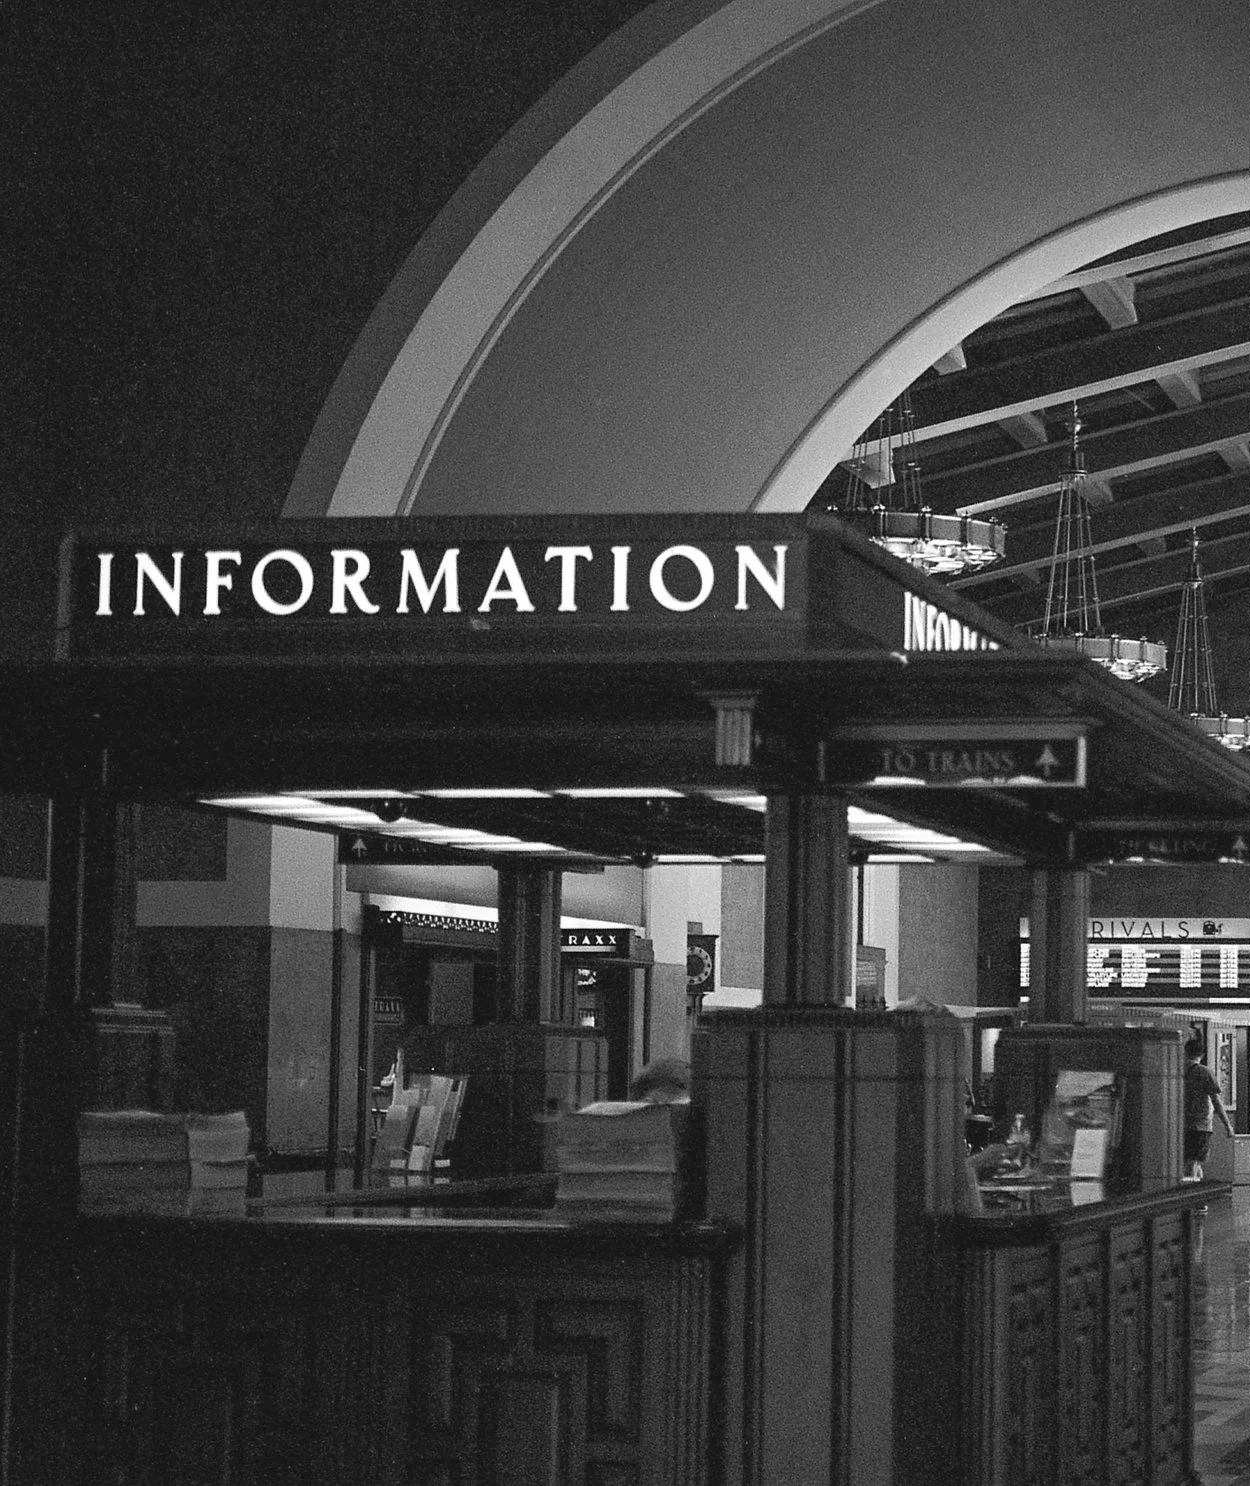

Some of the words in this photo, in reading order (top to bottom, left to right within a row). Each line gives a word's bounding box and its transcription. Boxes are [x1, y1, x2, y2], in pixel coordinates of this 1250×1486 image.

[96, 544, 789, 617] INFORMATION
[881, 747, 916, 772] TO
[927, 750, 1014, 773] TRAINS
[562, 934, 617, 946] RAXX
[1091, 920, 1190, 939] RIVALS
